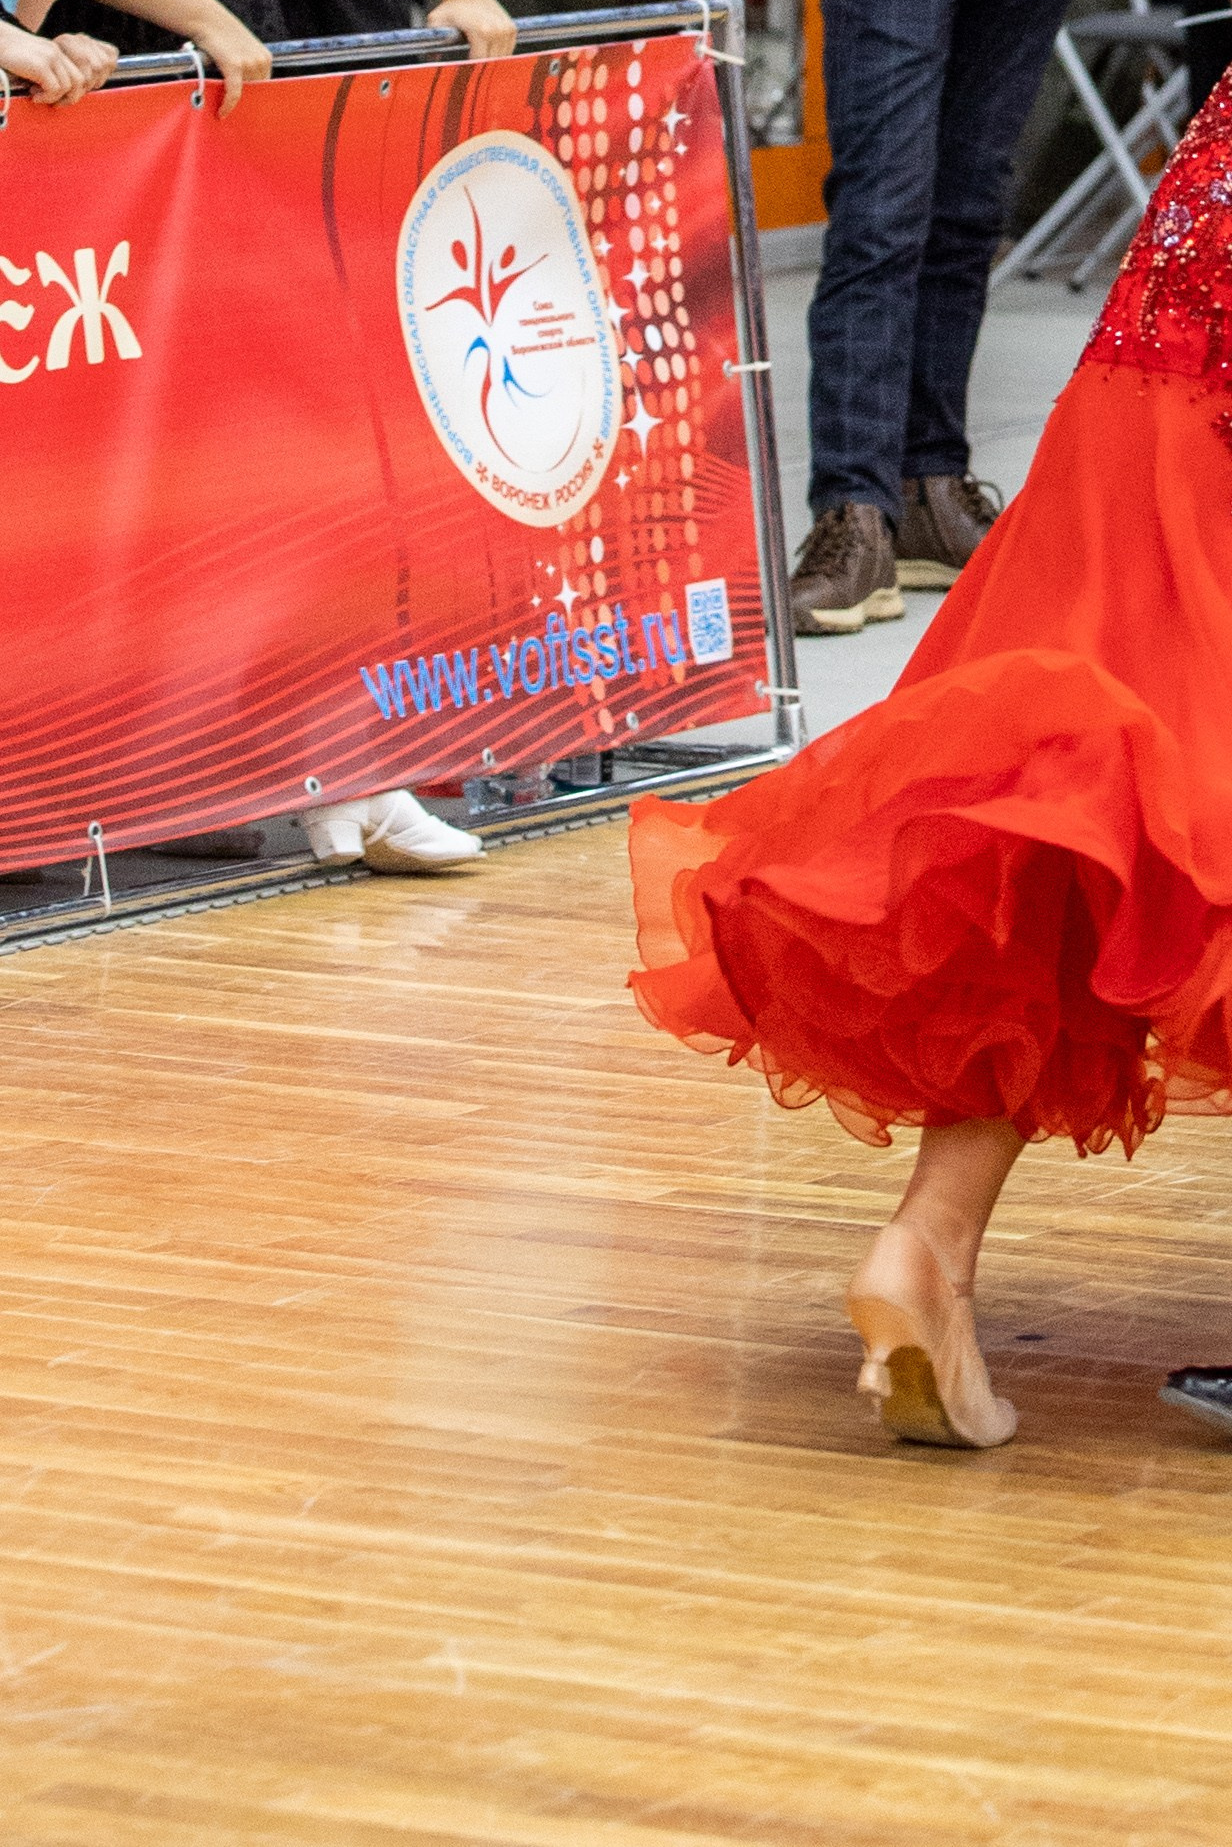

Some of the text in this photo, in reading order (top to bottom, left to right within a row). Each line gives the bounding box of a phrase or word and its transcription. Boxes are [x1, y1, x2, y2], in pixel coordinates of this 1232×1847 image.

[492, 457, 593, 510] ВОРОНЕЖ РОССИЯ
[360, 603, 687, 720] www.voftsst.ru
